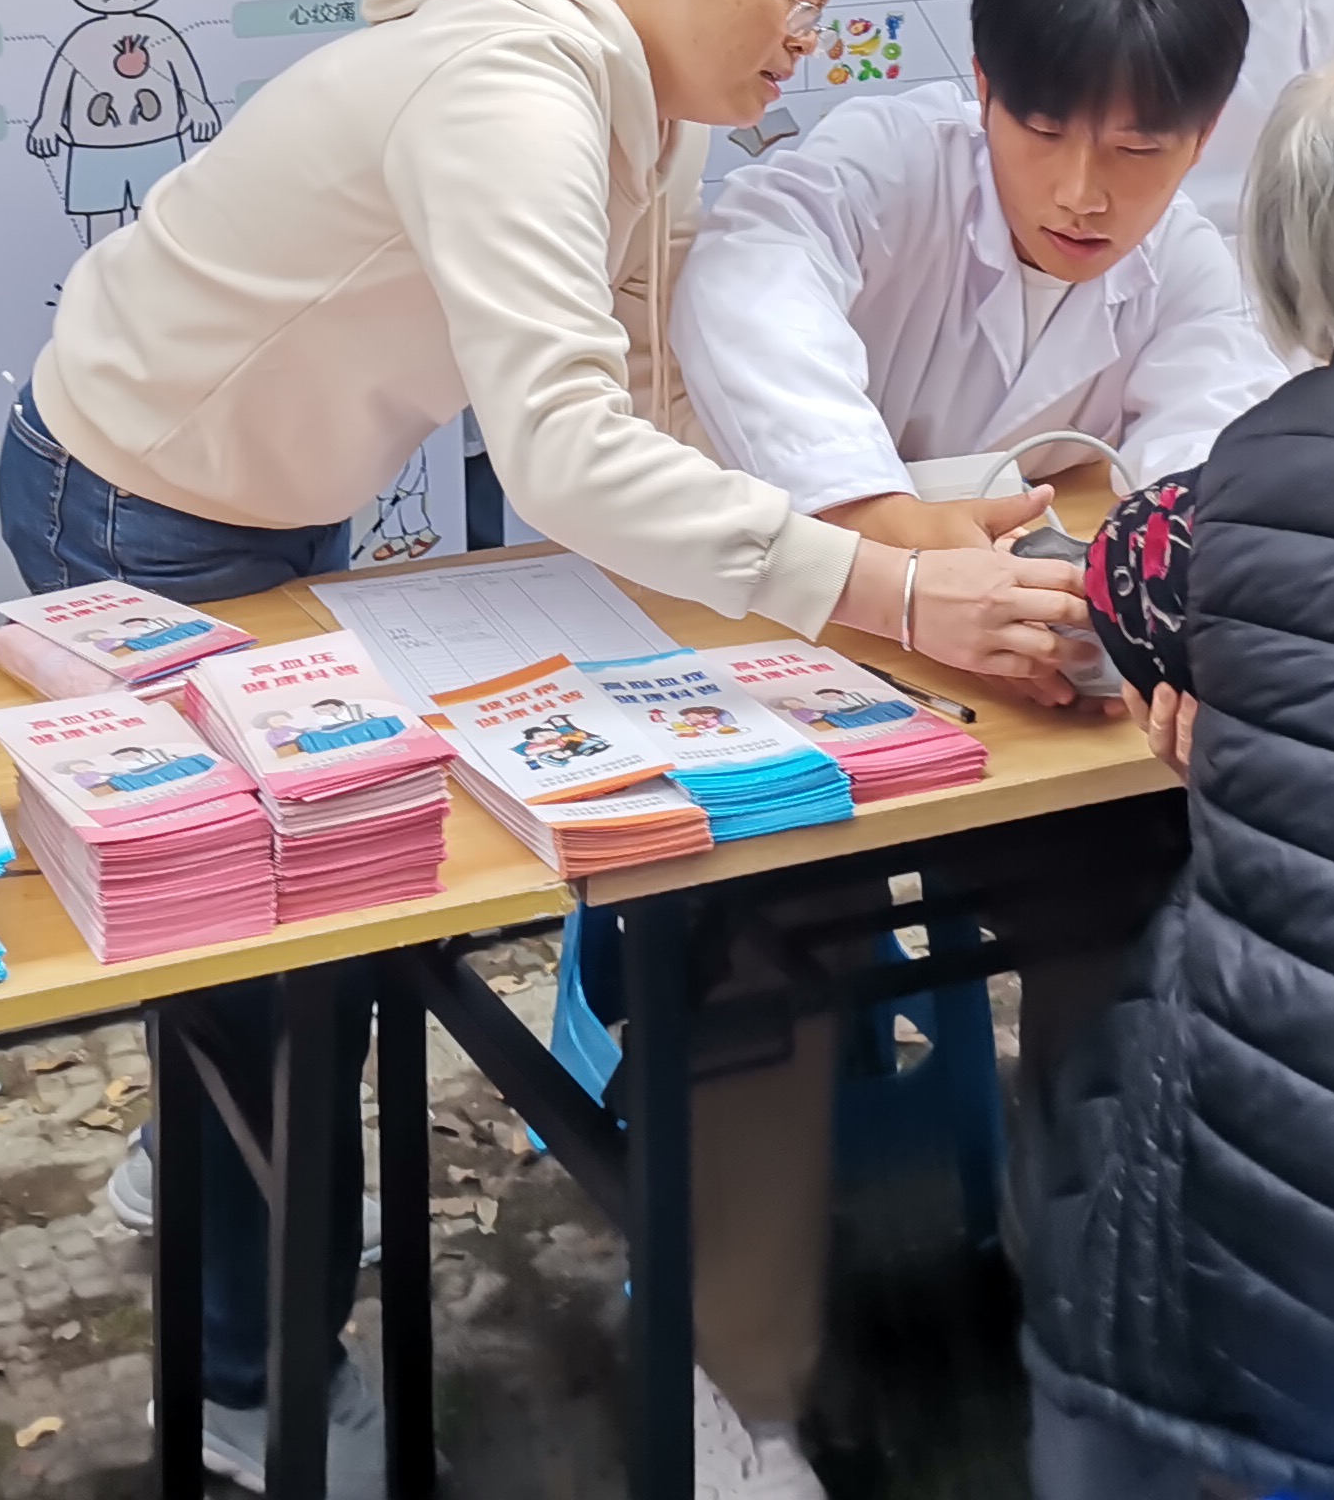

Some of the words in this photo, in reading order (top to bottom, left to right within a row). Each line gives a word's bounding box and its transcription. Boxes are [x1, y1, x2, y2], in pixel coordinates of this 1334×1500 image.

[288, 1, 357, 26] 心绞痛
[42, 593, 117, 614] 高血压
[248, 651, 338, 677] 高血压
[728, 653, 807, 673] 高血压
[240, 664, 361, 695] 健康科普
[27, 708, 117, 731] 高血压
[28, 716, 147, 746] 健康科普
